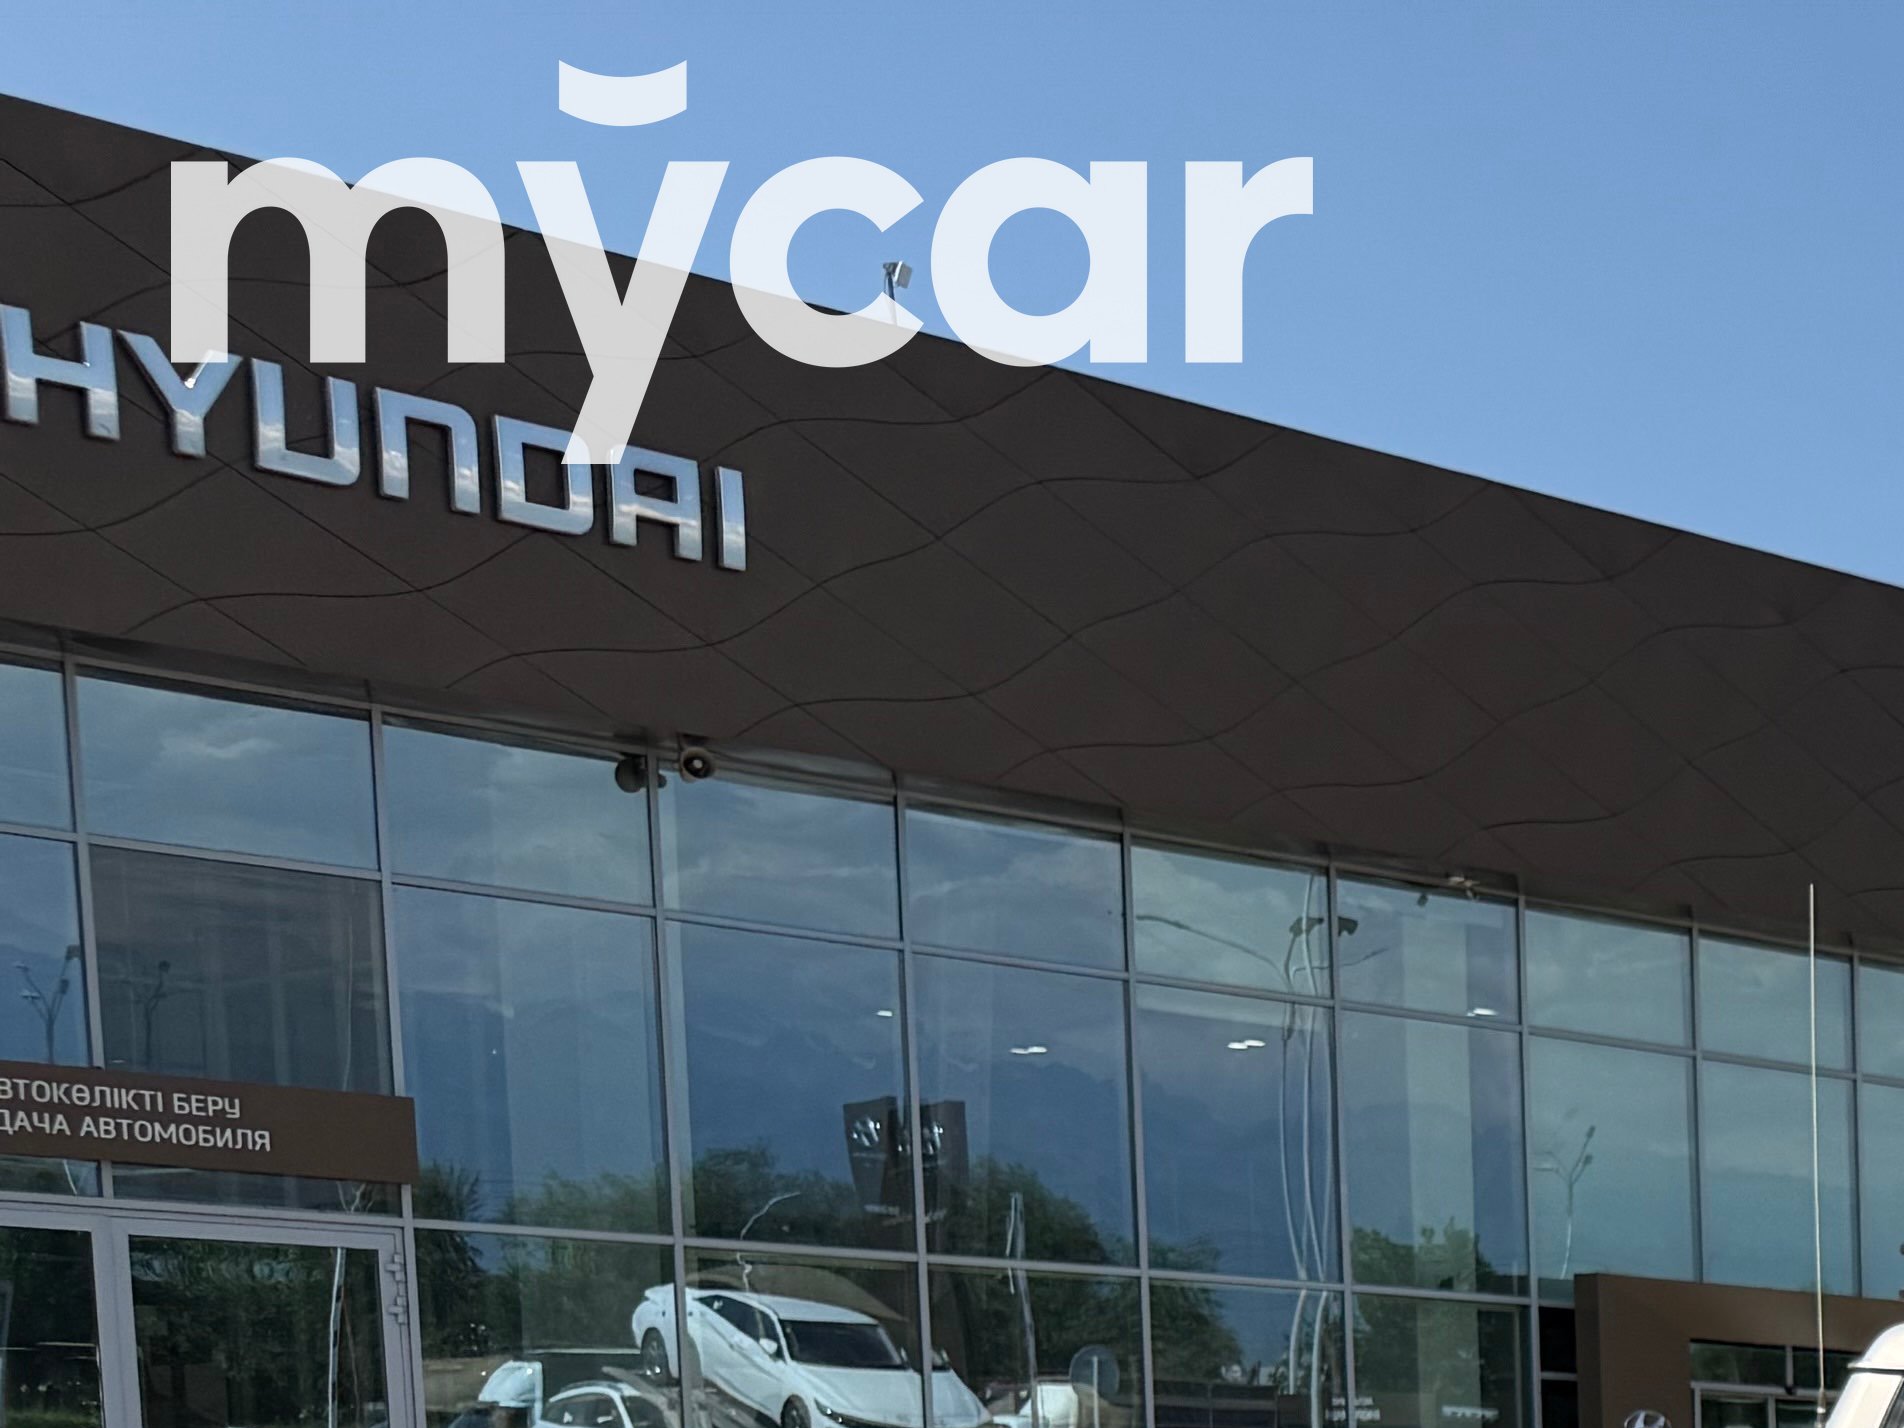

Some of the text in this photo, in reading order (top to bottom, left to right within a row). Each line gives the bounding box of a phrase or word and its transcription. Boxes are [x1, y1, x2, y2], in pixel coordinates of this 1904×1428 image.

[0, 303, 747, 572] HYUNDAI
[172, 1092, 242, 1119] БЕРУ
[79, 1115, 272, 1152] АВТОМОБИЛЯ
